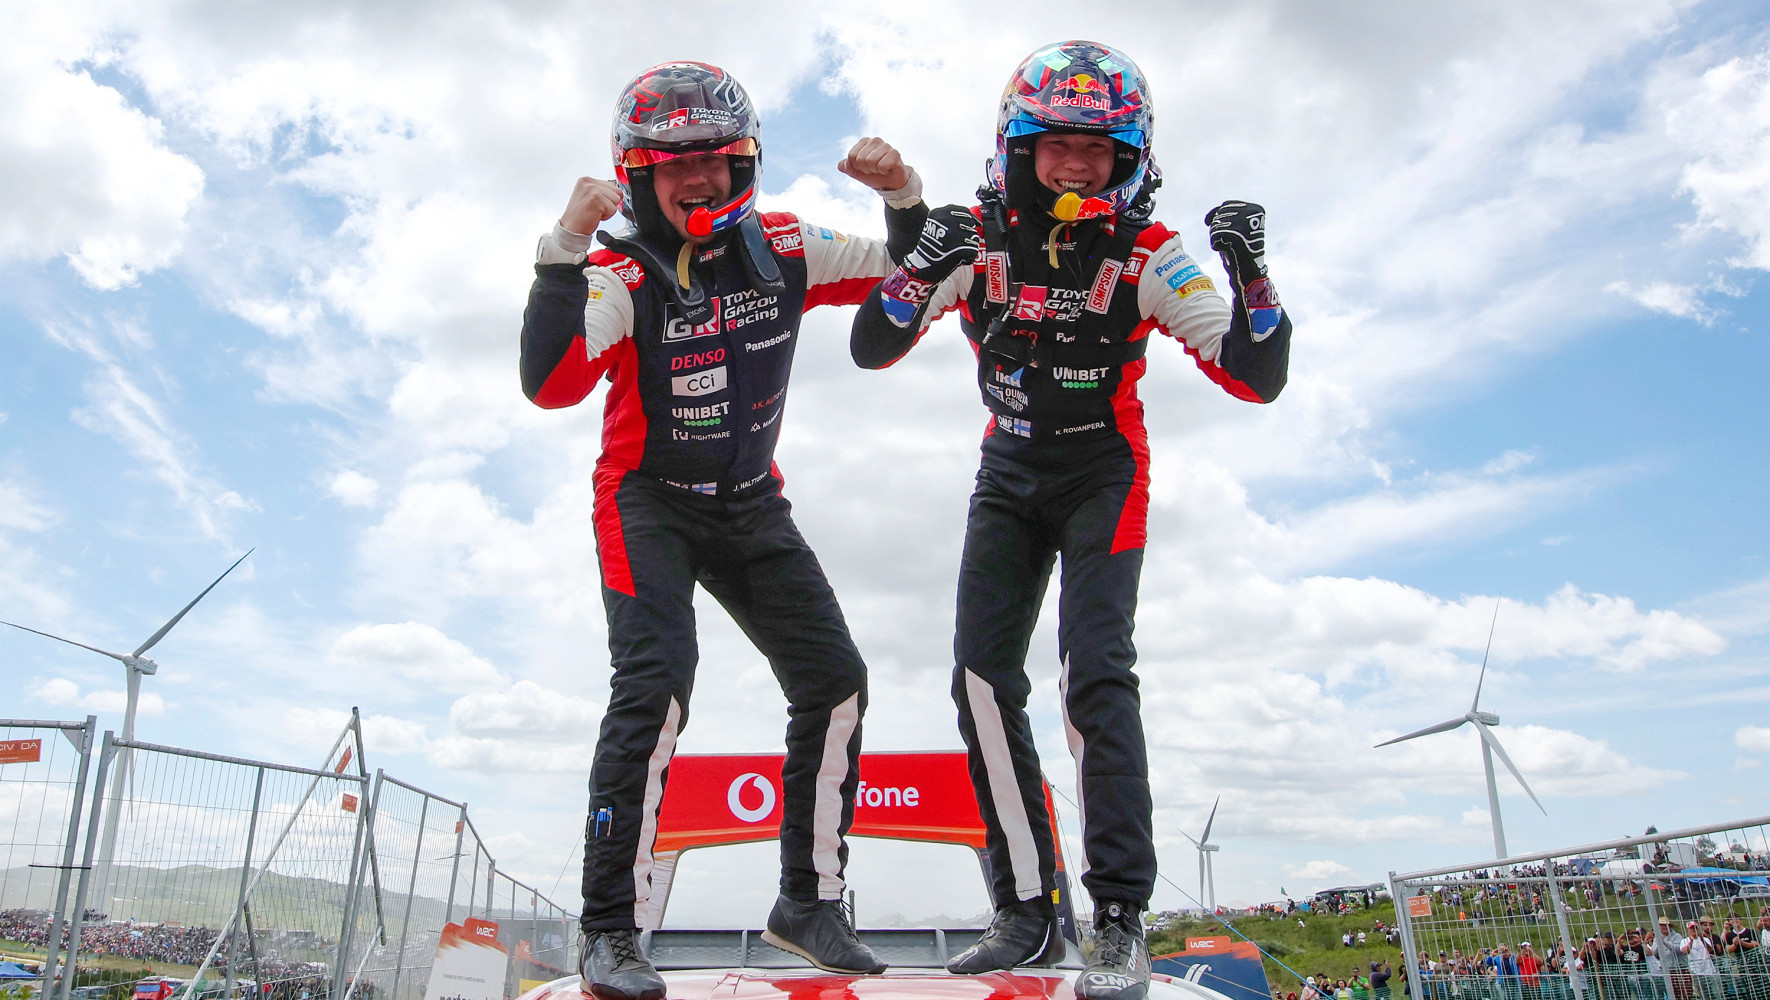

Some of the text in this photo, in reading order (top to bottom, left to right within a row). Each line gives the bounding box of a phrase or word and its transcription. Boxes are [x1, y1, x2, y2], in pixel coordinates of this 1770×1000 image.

[1051, 95, 1111, 111] Red Bull
[690, 107, 732, 117] TOYOTA
[651, 115, 686, 133] GR
[773, 236, 801, 251] OMP
[991, 257, 1001, 299] SIMPSON
[1092, 264, 1116, 308] SIMPSON
[725, 307, 779, 332] Racing
[745, 329, 792, 353] Panasonic
[671, 348, 726, 371] DENSO
[1053, 366, 1110, 381] UNIBET
[672, 401, 730, 419] UNIBET
[1005, 396, 1024, 413] GROUP
[997, 415, 1013, 430] OMP
[691, 430, 731, 441] RIGHTWARE
[856, 780, 920, 807] fone
[1190, 940, 1215, 948] WRC
